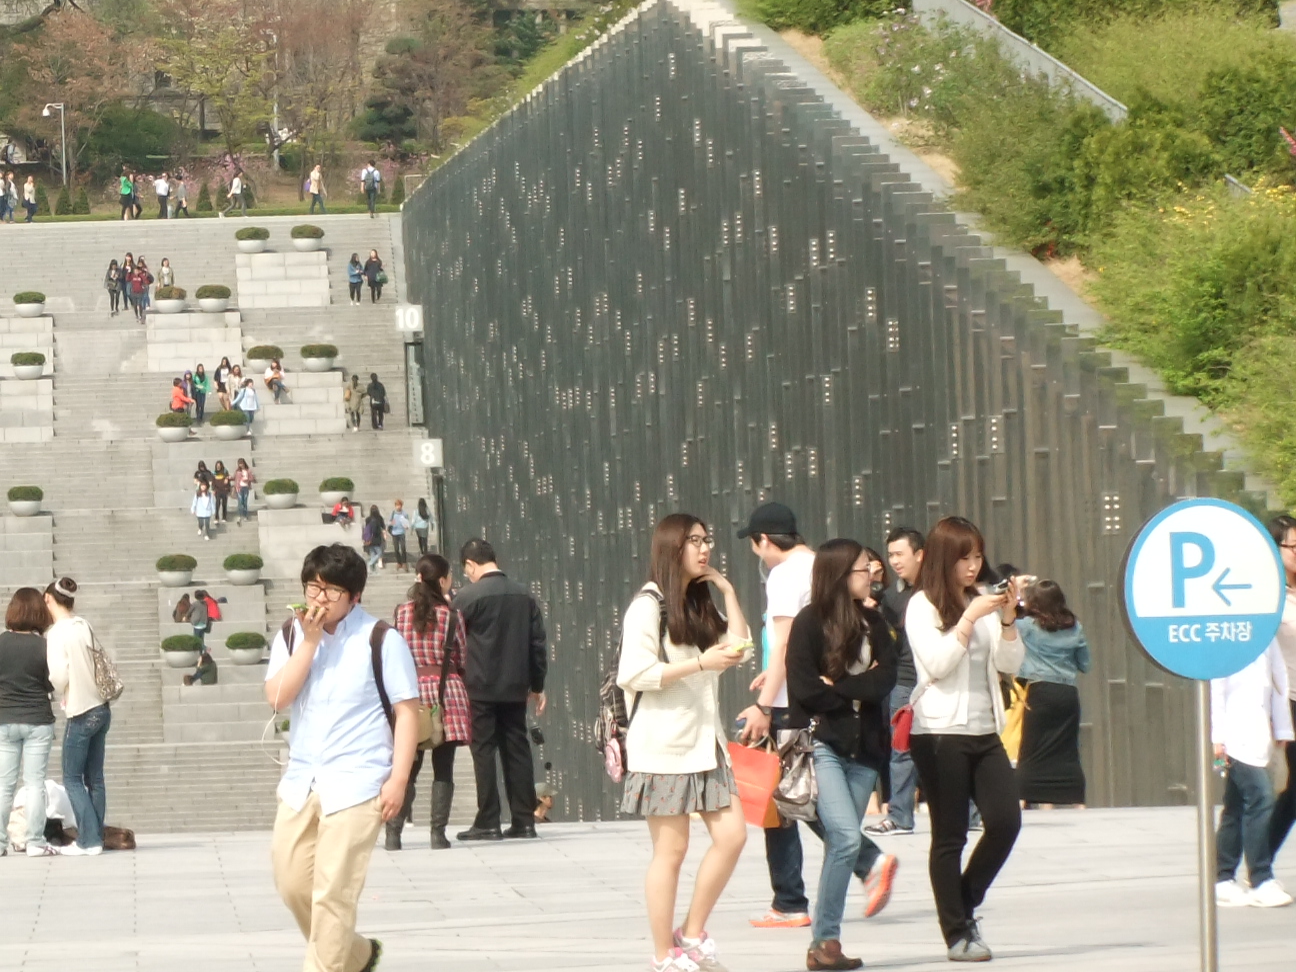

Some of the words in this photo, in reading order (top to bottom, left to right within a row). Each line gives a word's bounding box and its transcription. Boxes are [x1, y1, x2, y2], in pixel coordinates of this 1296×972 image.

[396, 306, 419, 329] 10
[420, 442, 435, 465] 8
[1169, 531, 1216, 609] P
[1168, 624, 1202, 643] ECC
[1204, 621, 1252, 642] 주차장
